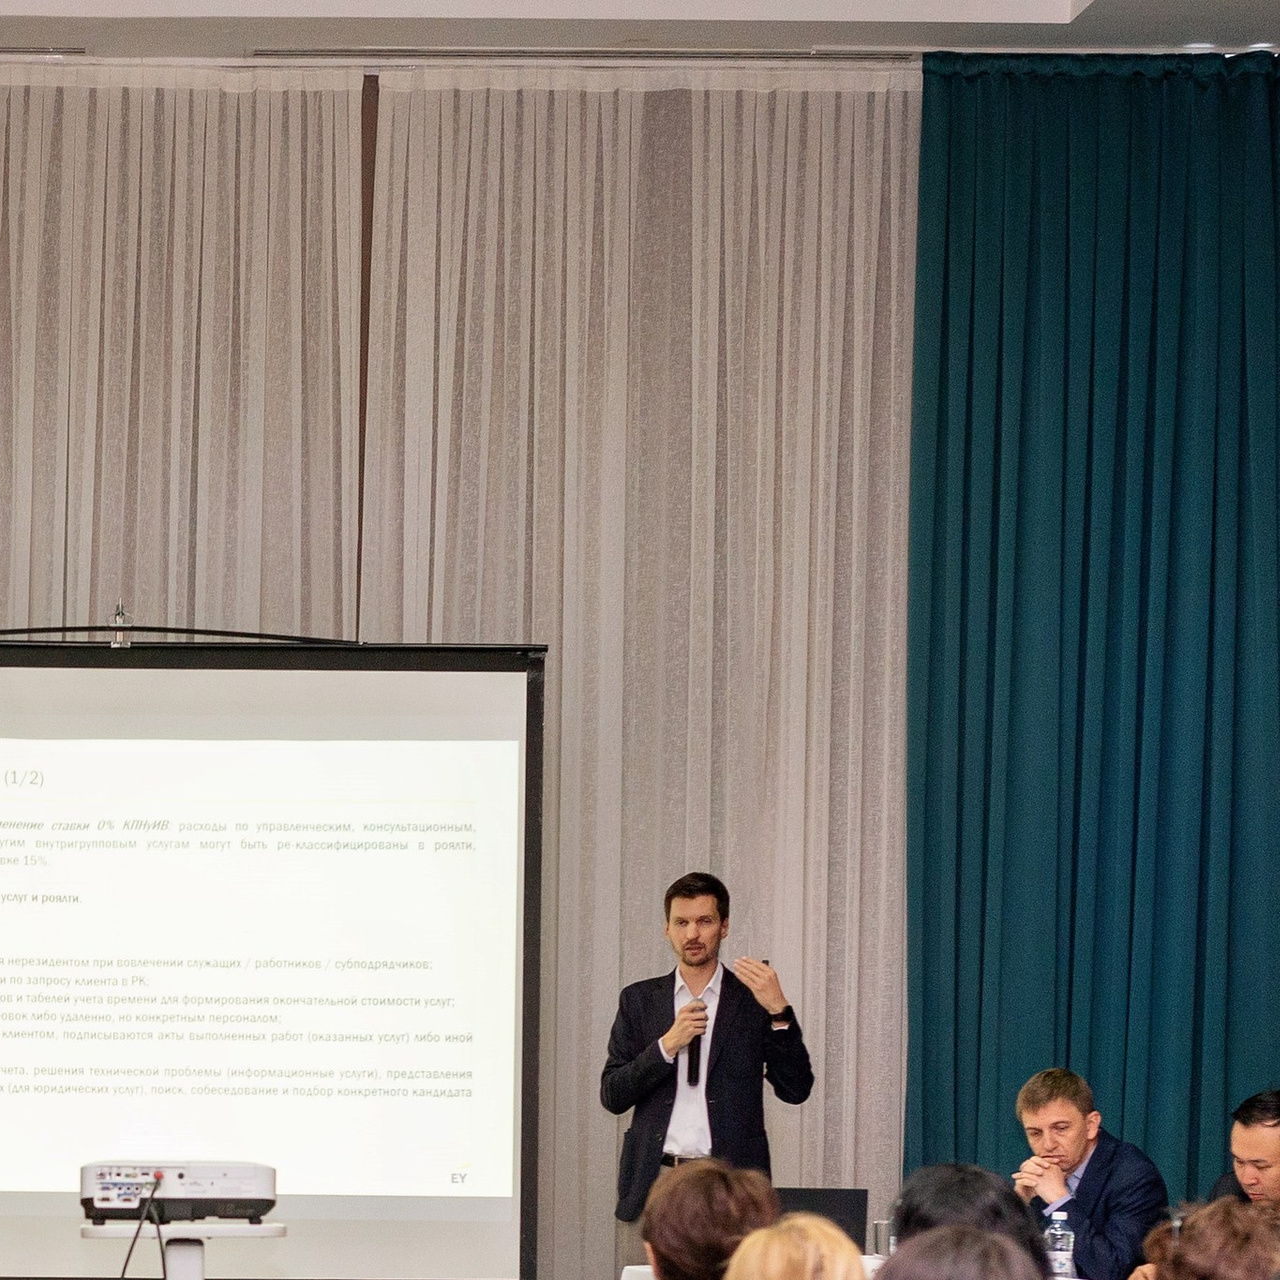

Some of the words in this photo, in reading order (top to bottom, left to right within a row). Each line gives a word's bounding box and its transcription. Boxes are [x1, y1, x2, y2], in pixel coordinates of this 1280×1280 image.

[4, 770, 44, 787] (1/2)
[48, 822, 92, 830] ставки
[178, 822, 227, 832] расходы
[235, 822, 249, 831] по
[362, 822, 476, 833] консультационным,
[35, 839, 137, 850] внутригрупповым
[146, 840, 190, 850] услугам
[199, 840, 231, 849] могут
[240, 838, 268, 849] быть
[277, 839, 409, 851] ре-классифицированы
[418, 841, 425, 850] в
[434, 841, 476, 852] роялти,
[0, 893, 28, 904] услуг
[31, 893, 39, 902] и
[7, 957, 90, 967] нерезидентом
[92, 959, 114, 969] при
[116, 958, 184, 967] вовлечении
[186, 959, 242, 969] служащих
[254, 957, 322, 969] работников
[9, 976, 23, 984] по
[26, 976, 72, 987] запросу
[74, 977, 119, 986] клиента
[121, 977, 128, 986] в
[16, 994, 23, 1002] и
[26, 993, 70, 1003] табелей
[73, 995, 104, 1004] учета
[106, 995, 157, 1005] времени
[160, 995, 179, 1005] для
[182, 995, 270, 1006] формирования
[272, 996, 358, 1006] окончательной
[360, 997, 421, 1006] стоимости
[423, 997, 455, 1008] услуг;
[30, 1011, 57, 1021] либо
[118, 1013, 132, 1022] но
[135, 1013, 206, 1024] конкретным
[62, 1030, 154, 1040] подписываются
[157, 1031, 184, 1040] акты
[188, 1031, 267, 1041] выполненных
[270, 1032, 304, 1042] работ
[307, 1032, 374, 1042] (оказанных
[377, 1032, 410, 1044] услуг)
[413, 1031, 441, 1042] либо
[444, 1032, 473, 1043] иной
[33, 1066, 85, 1076] решения
[89, 1067, 160, 1076] технической
[164, 1067, 222, 1077] проблемы
[226, 1067, 335, 1078] (информационные
[386, 1069, 473, 1080] представления
[7, 1084, 31, 1094] (для
[33, 1084, 109, 1094] юридических
[190, 1085, 279, 1095] собеседование
[282, 1087, 289, 1095] и
[292, 1086, 334, 1097] подбор
[337, 1087, 409, 1097] конкретного
[412, 1088, 473, 1098] кандидата
[451, 1173, 468, 1184] EY
